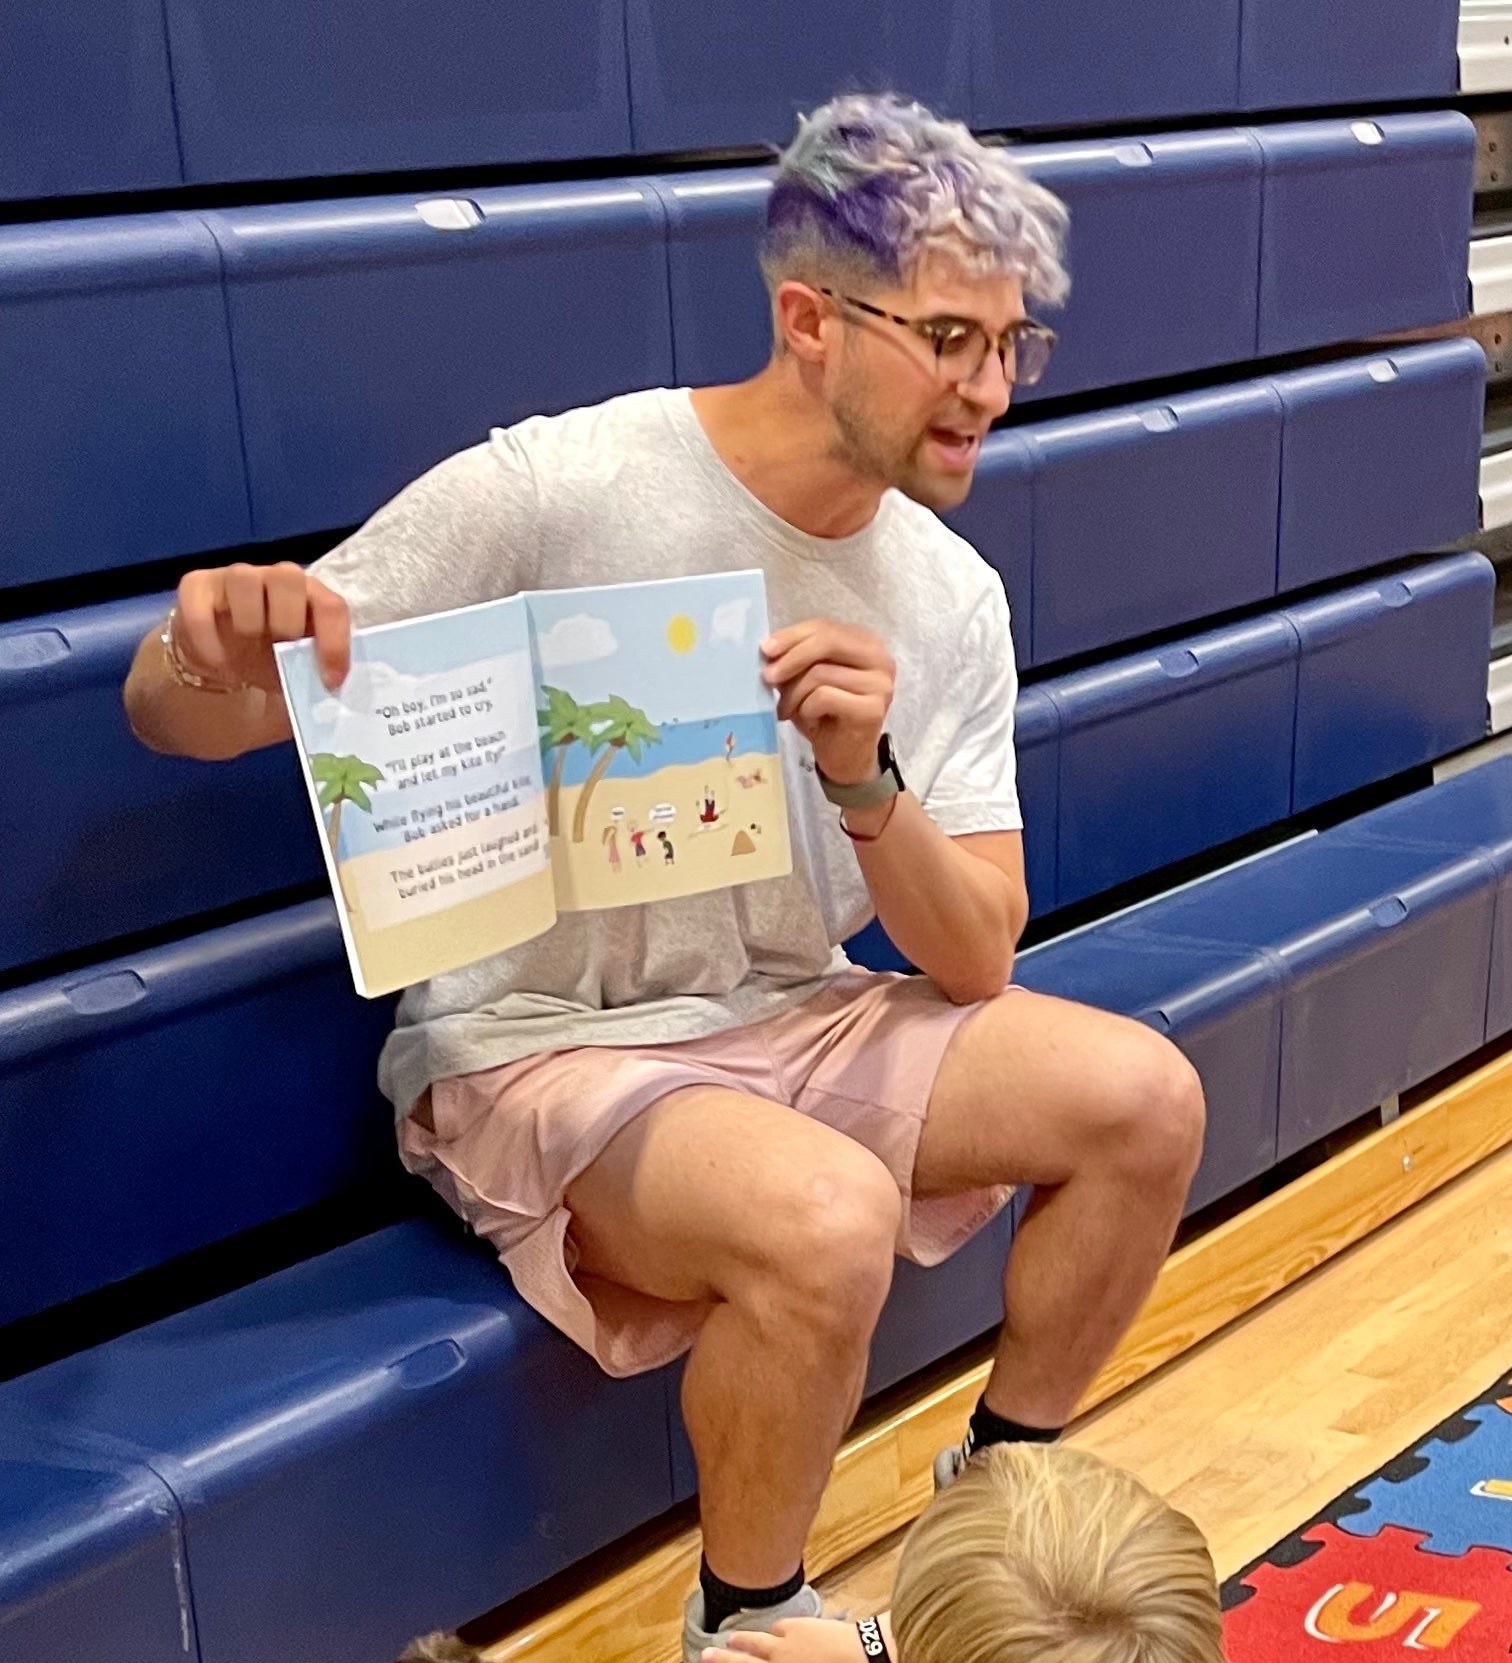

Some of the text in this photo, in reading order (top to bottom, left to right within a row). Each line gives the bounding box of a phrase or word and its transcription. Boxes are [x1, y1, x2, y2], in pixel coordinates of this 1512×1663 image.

[450, 689, 463, 701] so
[387, 721, 411, 736] Bob
[414, 708, 456, 730] started
[459, 704, 472, 717] to
[410, 752, 434, 769] play
[439, 746, 451, 759] at
[453, 741, 472, 754] the
[474, 730, 506, 748] beach
[398, 774, 418, 790] and
[420, 768, 439, 783] let
[441, 765, 457, 777] my
[460, 756, 482, 770] kite
[373, 816, 408, 833] While
[411, 805, 443, 823] flying
[464, 781, 509, 805] beautiful
[403, 827, 426, 843] Bob
[430, 816, 462, 834] asked
[464, 810, 481, 822] for
[390, 824, 538, 883] The bullies just laughed and
[398, 877, 436, 899] buried
[438, 873, 455, 885] his
[457, 862, 484, 879] head
[498, 852, 515, 864] the
[1305, 1580, 1483, 1650] 5
[857, 1616, 884, 1657] 620
